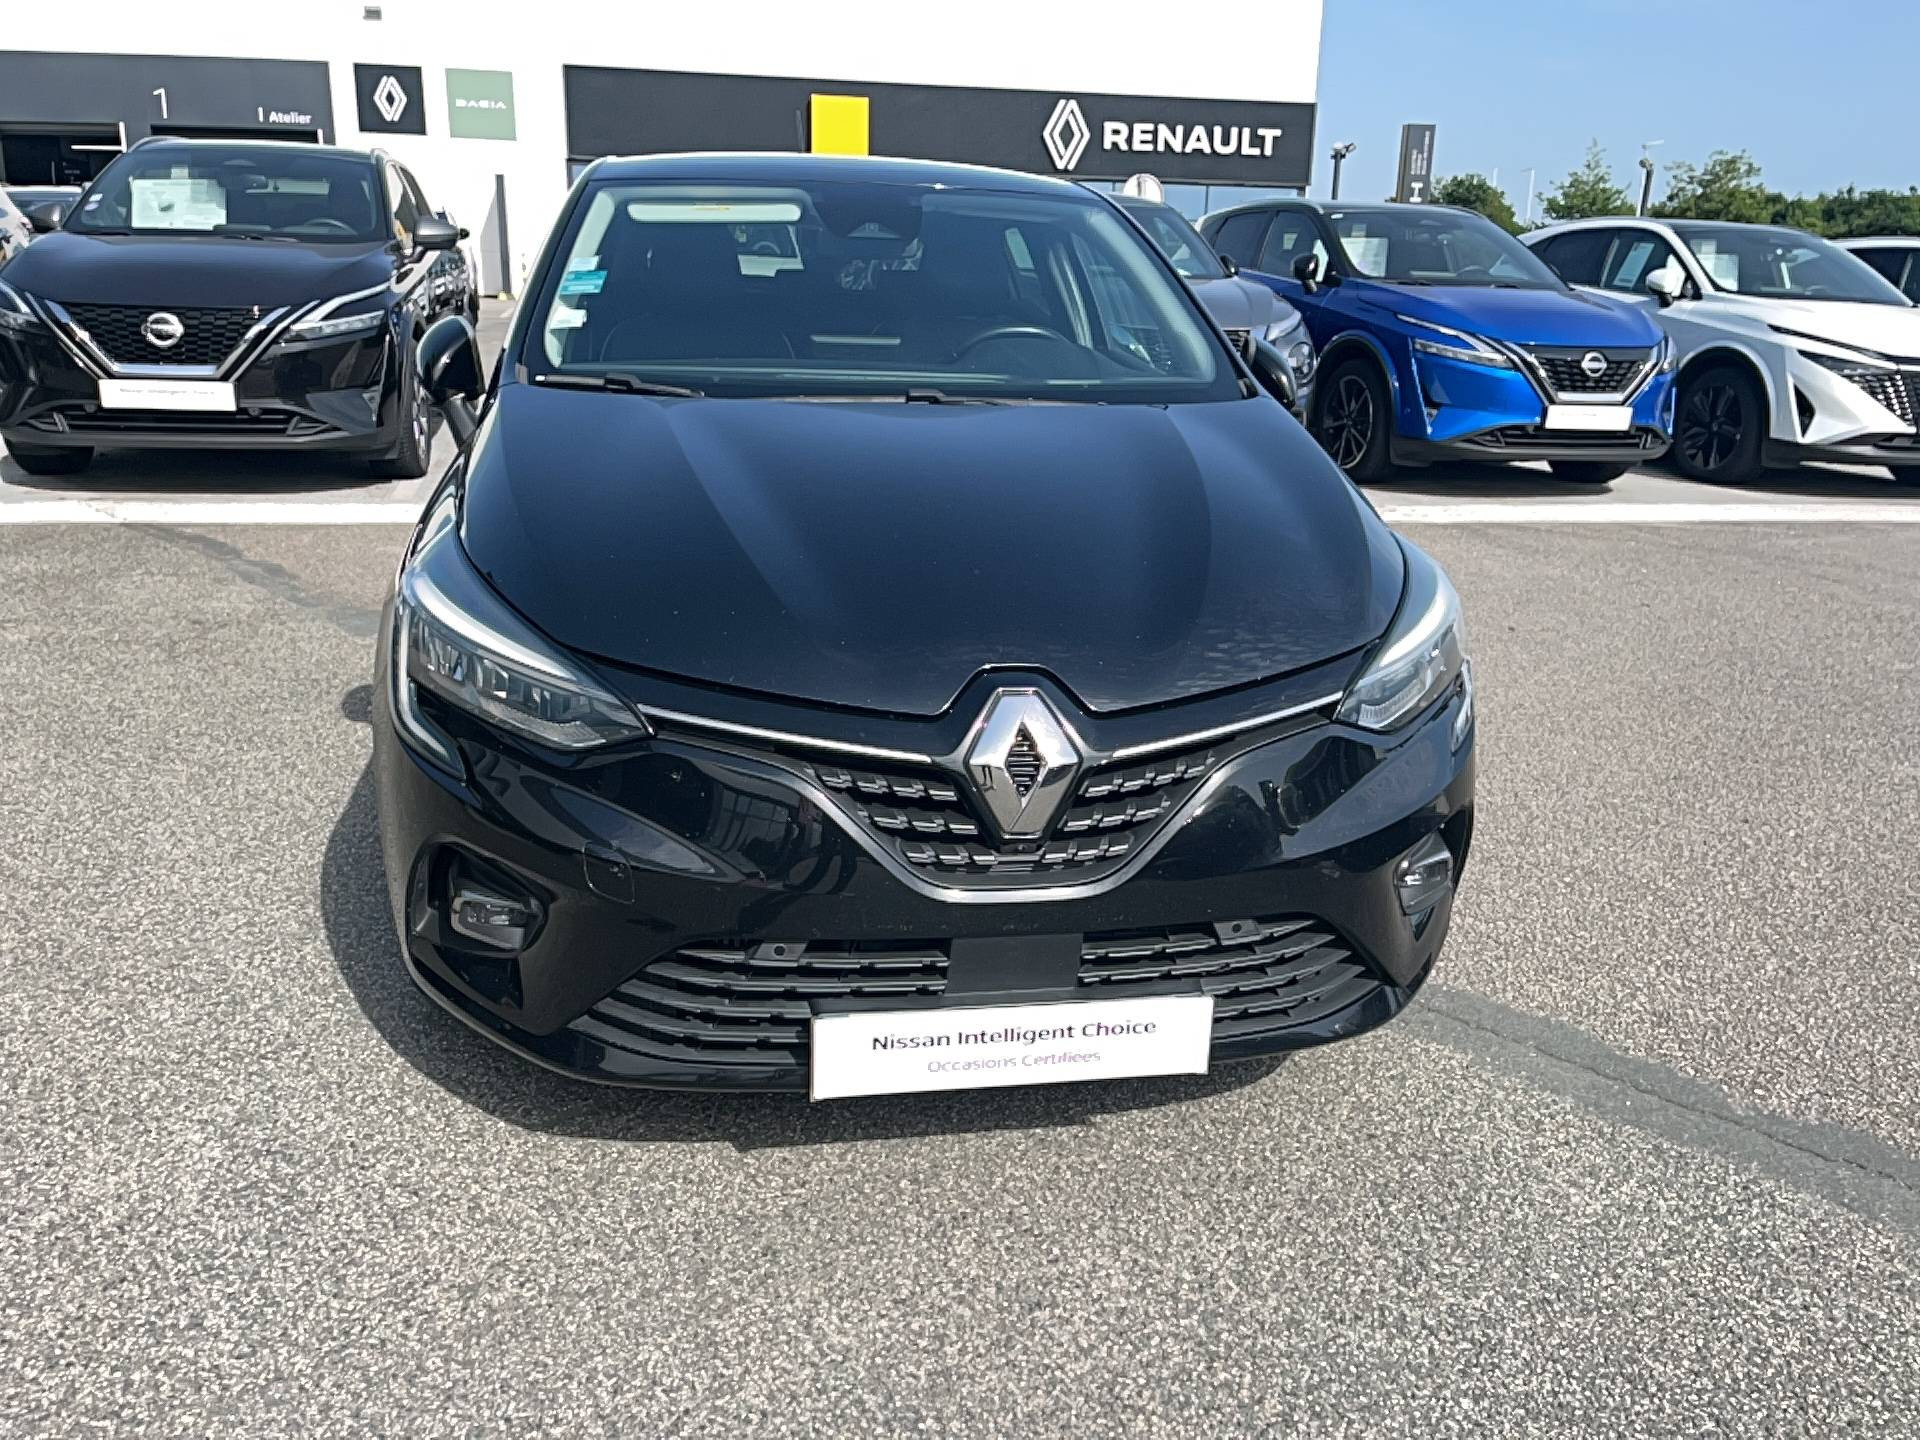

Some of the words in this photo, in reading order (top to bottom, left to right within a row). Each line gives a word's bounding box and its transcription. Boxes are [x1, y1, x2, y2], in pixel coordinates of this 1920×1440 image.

[153, 87, 168, 119] 1
[268, 111, 312, 124] Atelier
[1102, 120, 1282, 157] RENAULT
[872, 1034, 951, 1050] Nissan
[957, 1023, 1076, 1045] Intelligent
[1082, 1020, 1157, 1038] Choice
[927, 1056, 1017, 1072] Occasions
